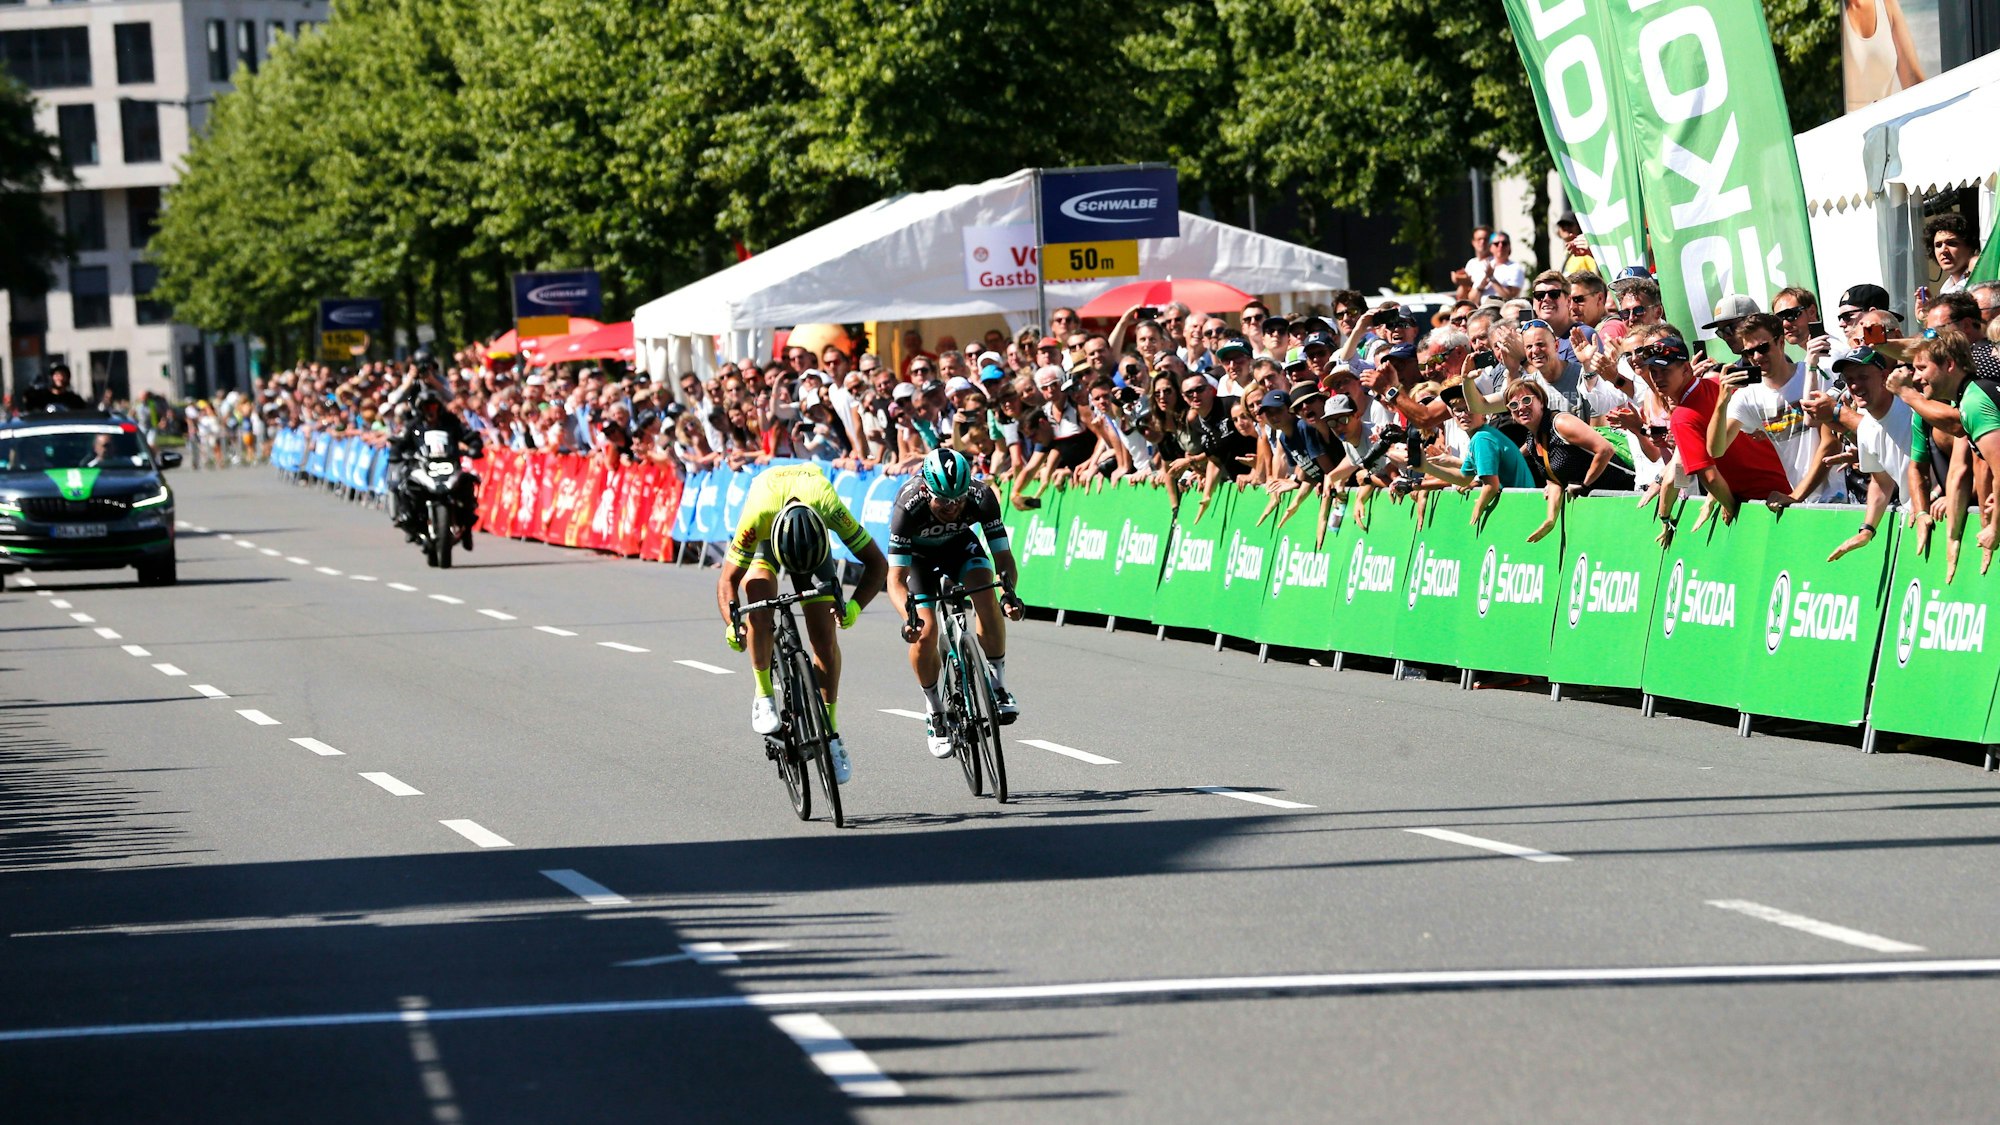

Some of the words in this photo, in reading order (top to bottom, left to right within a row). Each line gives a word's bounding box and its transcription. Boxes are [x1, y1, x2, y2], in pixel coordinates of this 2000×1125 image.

[1077, 197, 1159, 213] SCHWALBE
[1069, 248, 1098, 271] 50
[1101, 257, 1115, 270] m
[920, 522, 969, 538] BORA
[1074, 522, 1108, 561] ŠKODA
[1125, 525, 1159, 566] ŠKODA
[1177, 531, 1214, 572] ŠKODA
[1234, 537, 1264, 581] ŠKODA
[1285, 543, 1331, 588] ŠKODA
[1358, 546, 1396, 593] ŠKODA
[1421, 549, 1461, 597] ŠKODA
[1495, 554, 1544, 604] ŠKODA
[1587, 561, 1641, 613] ŠKODA
[1681, 569, 1736, 628] ŠKODA
[1789, 581, 1860, 642] ŠKODA
[1919, 589, 1987, 653] ŠKODA
